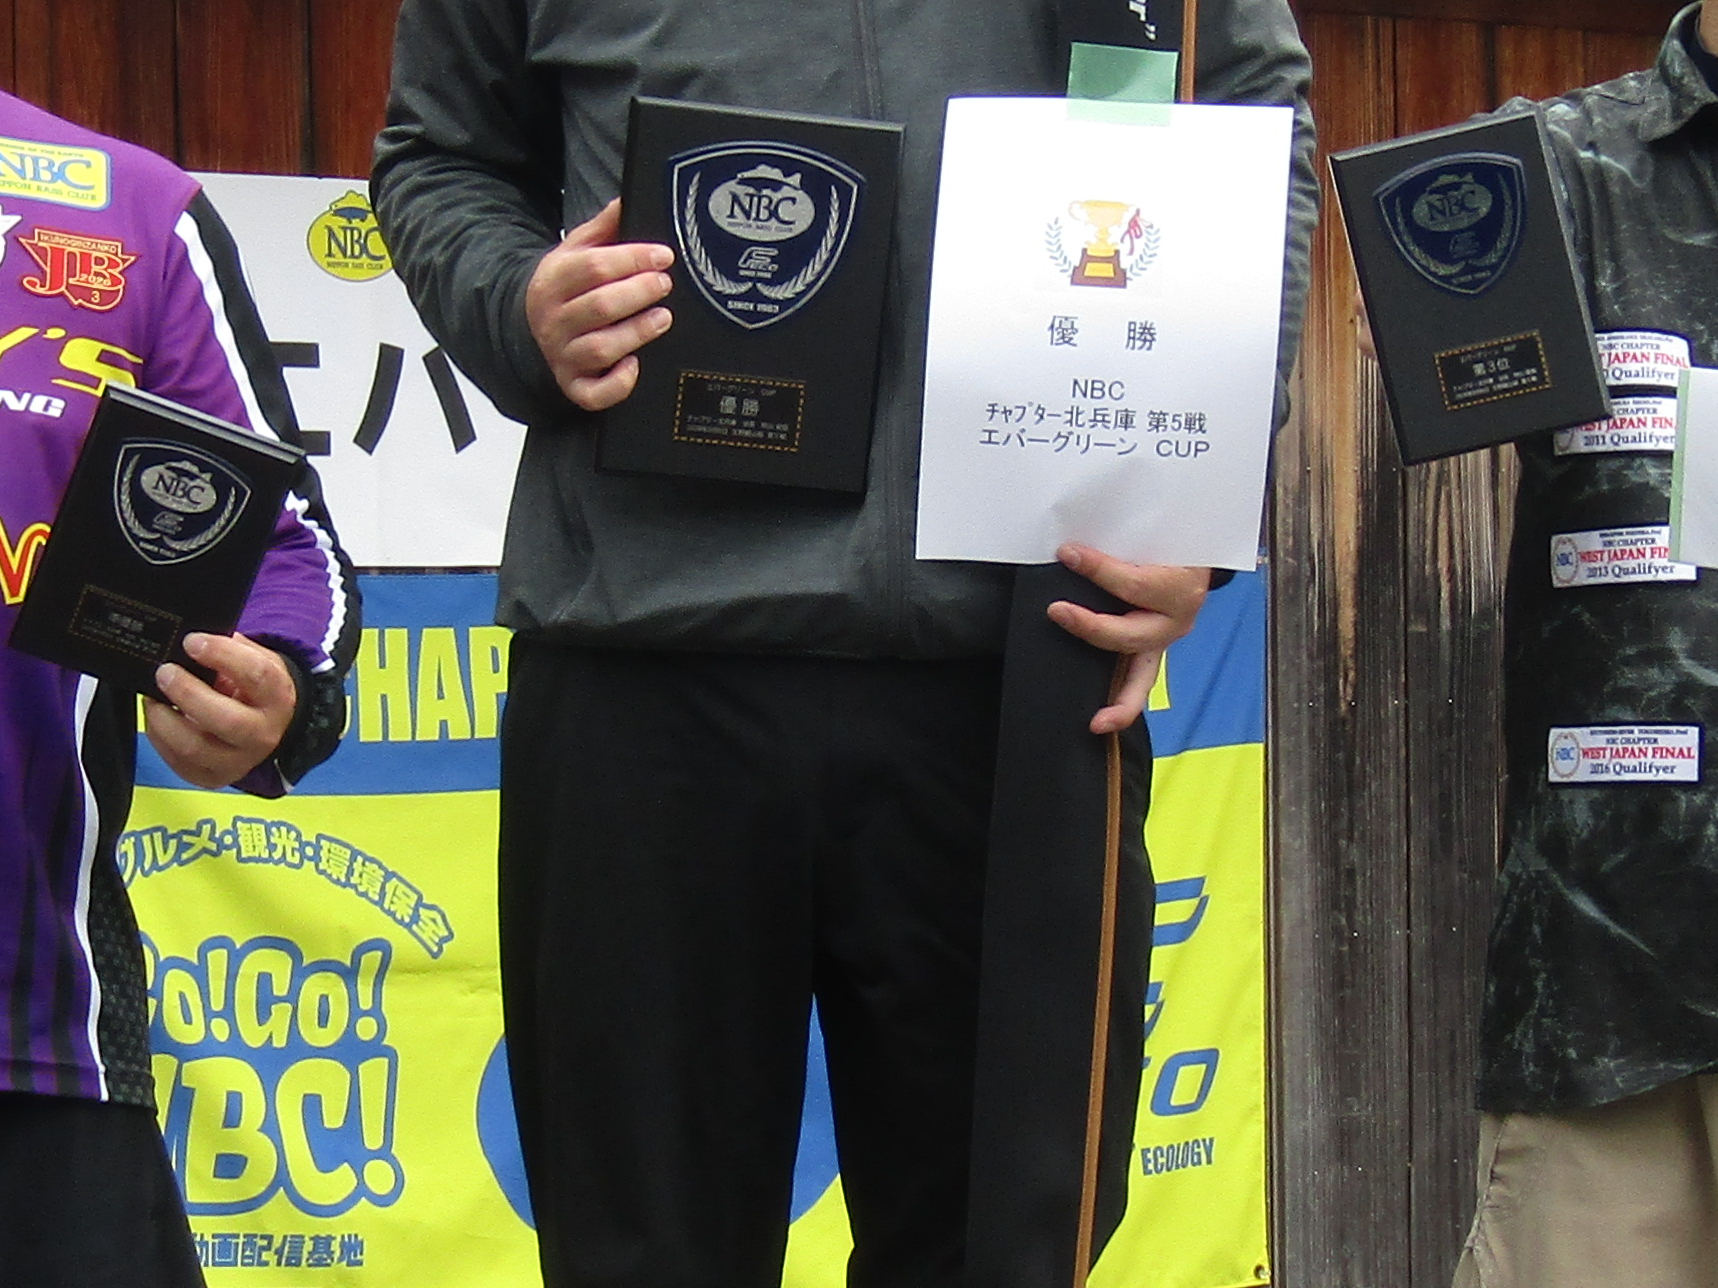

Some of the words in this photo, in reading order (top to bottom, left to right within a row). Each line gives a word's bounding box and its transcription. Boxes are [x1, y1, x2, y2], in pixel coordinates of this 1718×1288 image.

[726, 191, 797, 226] NBC
[1425, 189, 1483, 222] NBC
[324, 225, 387, 261] NBC
[23, 243, 125, 295] JB
[90, 290, 101, 303] 3
[1620, 341, 1661, 351] CHAPTER
[1608, 352, 1651, 367] JAPAN
[1654, 352, 1690, 369] FINAL
[1612, 367, 1675, 383] Qualifyer
[1071, 378, 1126, 402] NBC
[1146, 410, 1208, 435] 第5戦
[1605, 417, 1648, 434] JAPAN
[1652, 416, 1677, 430] FIN
[979, 426, 1139, 457] エバーグリーン
[1155, 439, 1211, 459] CUP
[1610, 432, 1675, 447] Qualifyer
[151, 473, 205, 505] NBC
[1617, 537, 1657, 547] CHAPTER
[1577, 550, 1605, 562] WEST
[1606, 547, 1647, 563] JAPAN
[1611, 563, 1676, 579] Qualifyer
[1581, 746, 1608, 759] WEST
[1608, 746, 1650, 763] JAPAN
[1651, 746, 1696, 759] FINAL
[1612, 761, 1678, 777] Qualifyer
[141, 936, 392, 1049] o!Go!
[1140, 1137, 1215, 1177] ECOLOGY
